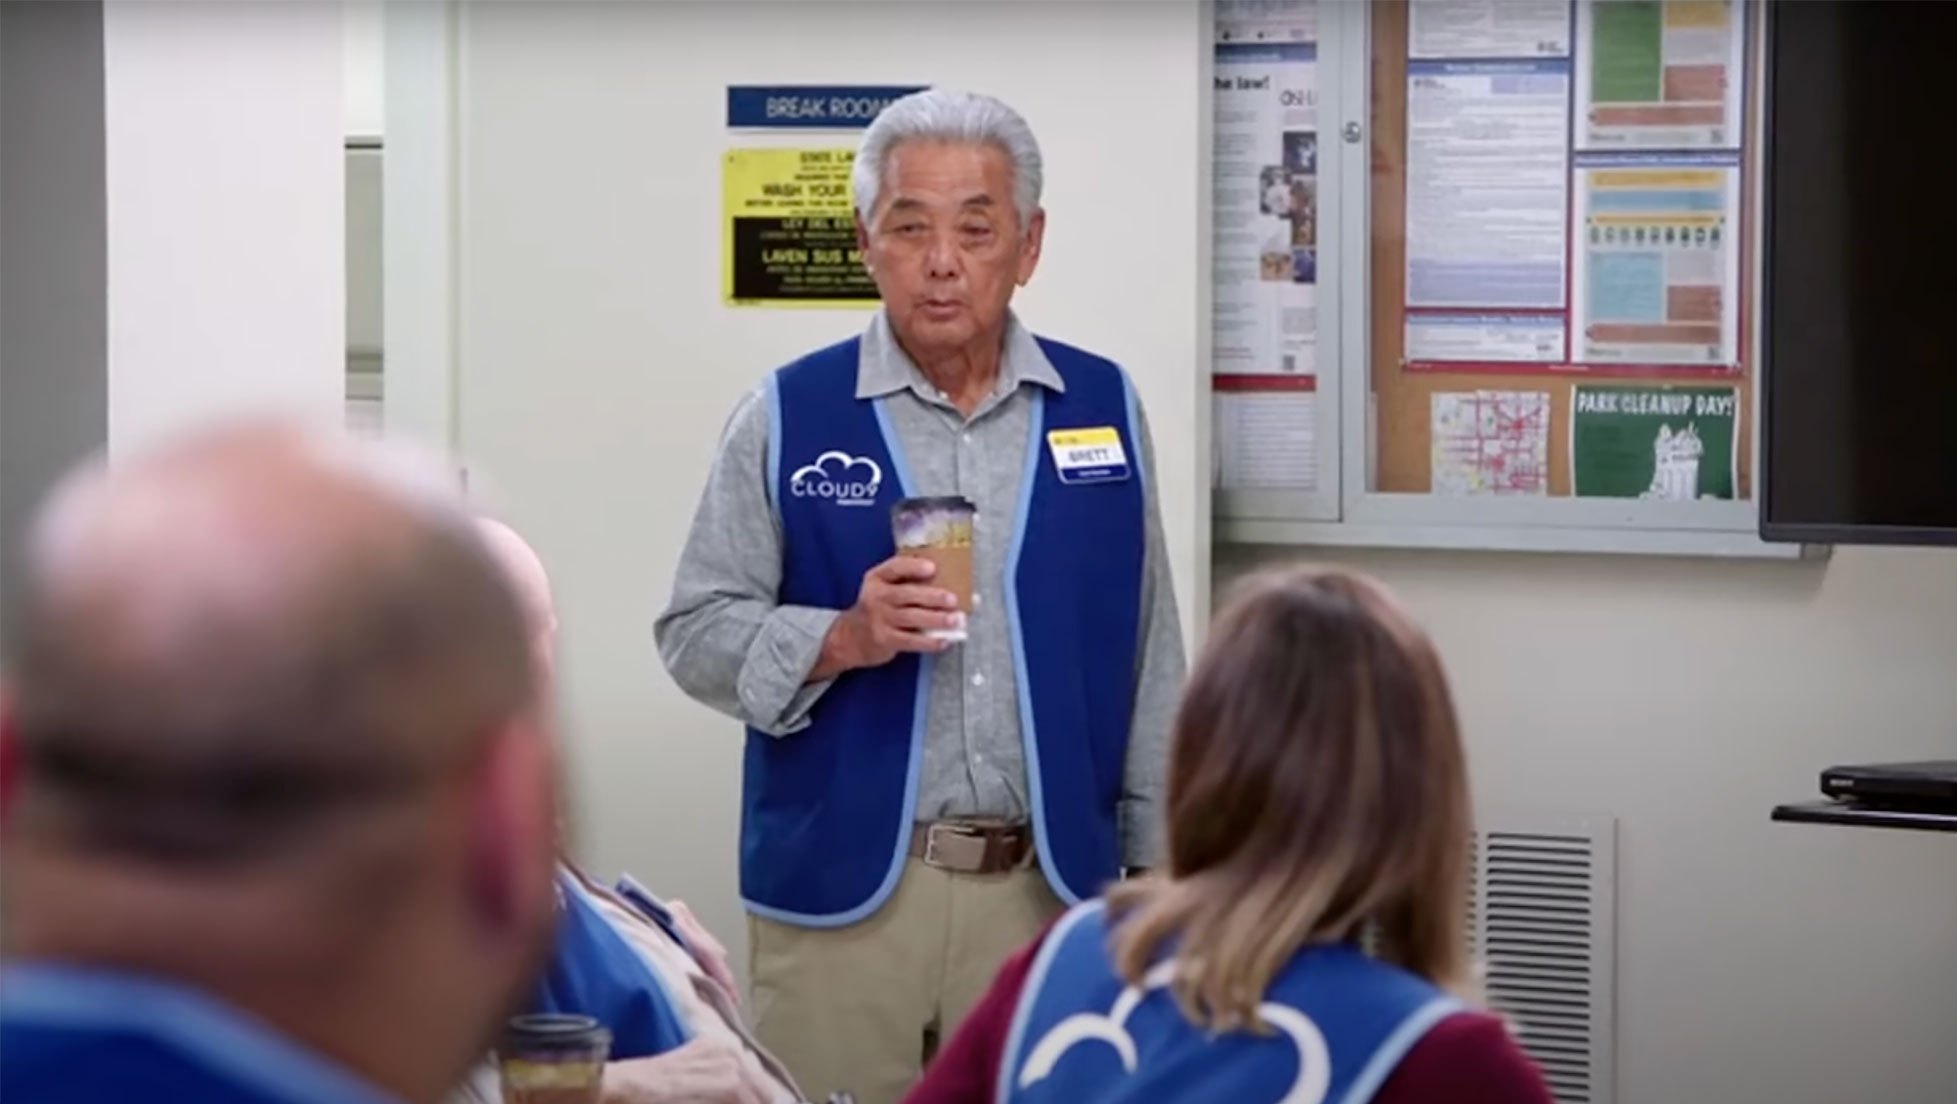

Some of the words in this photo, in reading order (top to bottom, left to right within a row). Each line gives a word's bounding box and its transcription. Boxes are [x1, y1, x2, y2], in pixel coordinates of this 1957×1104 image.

[1213, 75, 1233, 90] he
[1237, 75, 1270, 90] law!
[766, 97, 826, 118] BREAK
[801, 152, 832, 164] STATE
[837, 152, 857, 164] LA
[762, 183, 802, 197] WASH
[808, 183, 847, 197] YOUR
[782, 218, 804, 230] LEY
[762, 249, 808, 264] LAVEN
[812, 249, 844, 264] SUS
[1578, 392, 1619, 413] PARK
[1621, 393, 1692, 415] CLEANUP
[1695, 395, 1734, 416] DAY!
[1069, 448, 1110, 462] BRETT
